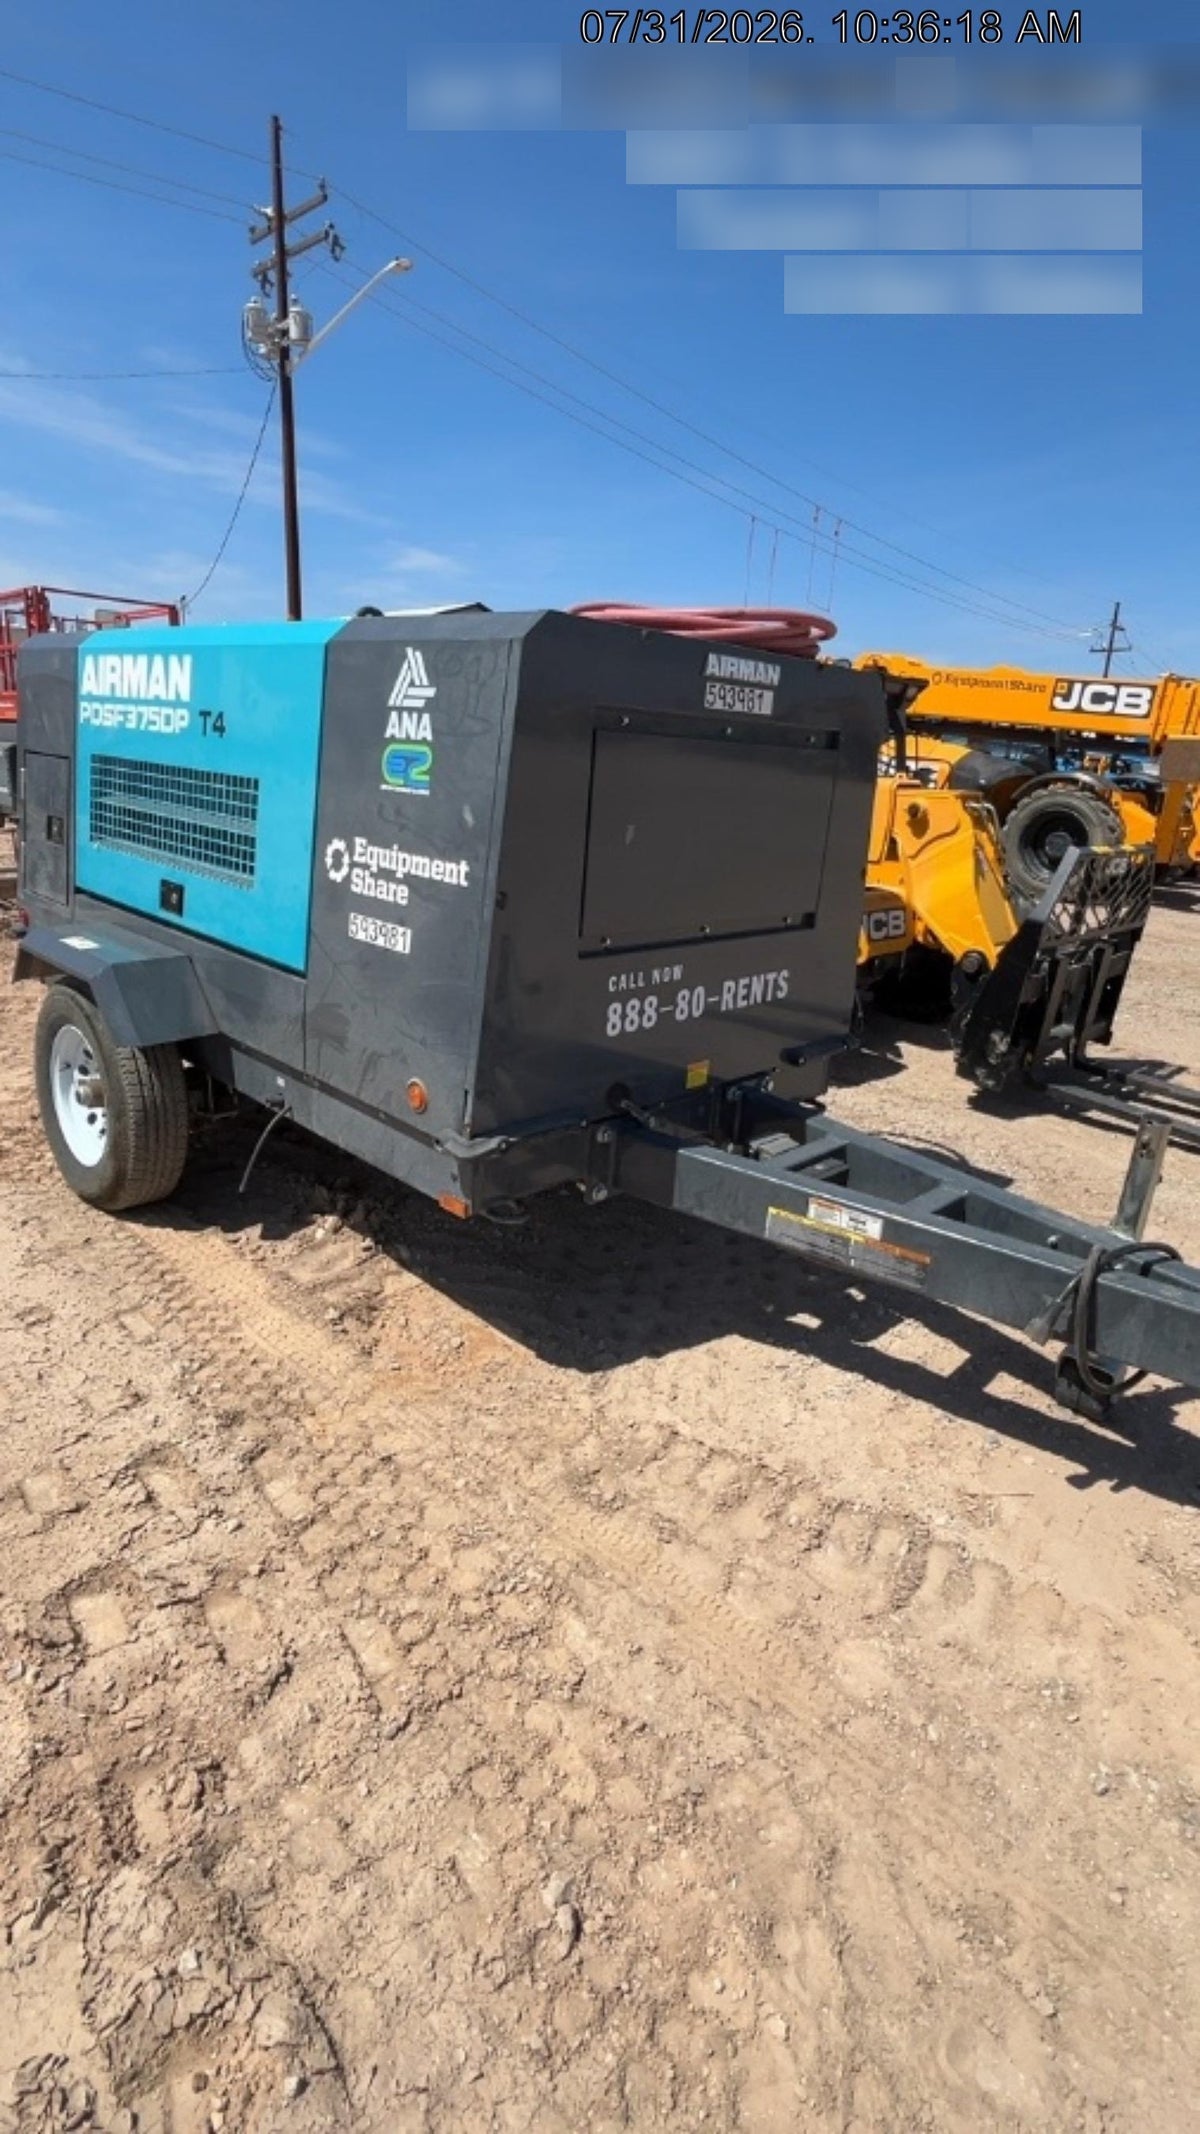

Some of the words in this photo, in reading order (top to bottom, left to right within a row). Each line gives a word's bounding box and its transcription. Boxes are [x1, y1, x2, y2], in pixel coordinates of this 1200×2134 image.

[80, 653, 193, 702] AIRMAN
[704, 652, 781, 686] AIRMAN
[705, 684, 765, 713] 593981
[1052, 681, 1153, 716] JCB
[198, 710, 226, 738] T4
[384, 710, 433, 741] ANA
[353, 836, 470, 887] Equipment
[350, 867, 409, 906] Share
[350, 912, 410, 953] 593981
[608, 971, 646, 992] CALL
[652, 964, 684, 985] NOW
[606, 969, 789, 1037] 888-80-RENTS
